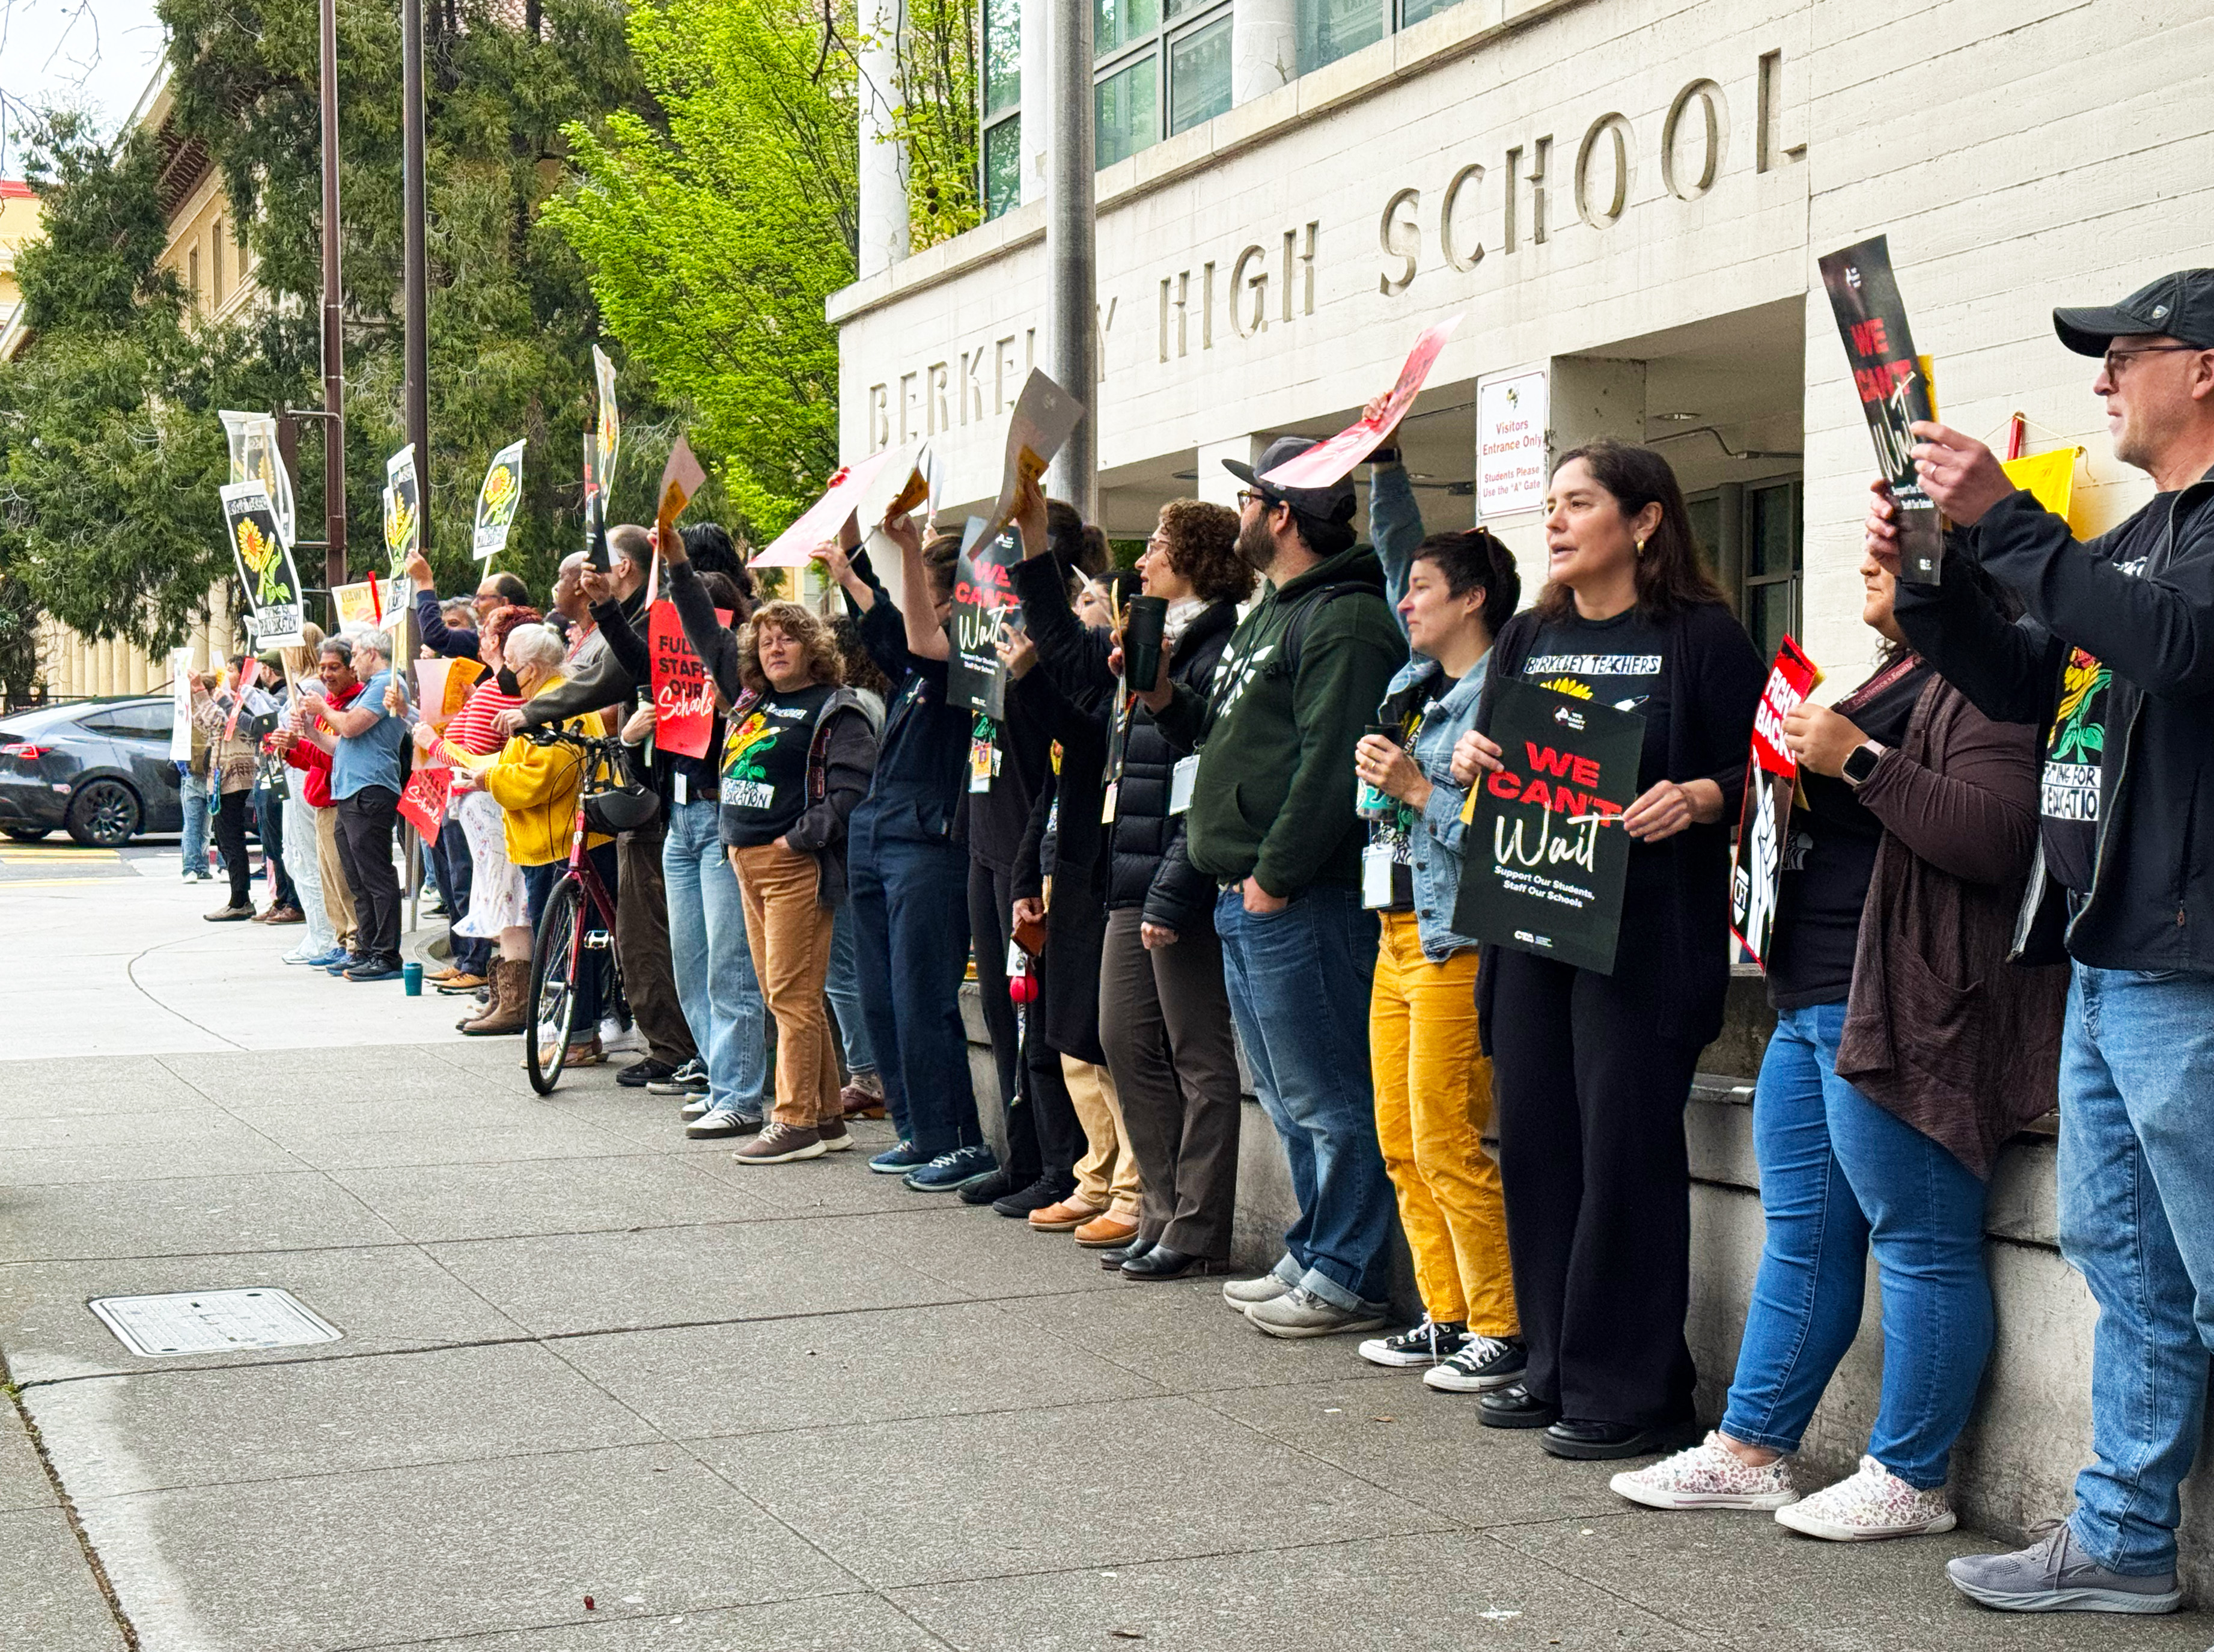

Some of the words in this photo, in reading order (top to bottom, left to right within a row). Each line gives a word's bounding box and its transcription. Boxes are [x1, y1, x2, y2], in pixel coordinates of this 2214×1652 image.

[1159, 219, 1320, 364] HIGH
[1380, 48, 1807, 297] SCHOOL
[1850, 317, 1889, 357] WE
[1496, 420, 1529, 435] Visitors
[1483, 440, 1520, 456] Entrance
[1523, 434, 1543, 448] Only
[1484, 469, 1514, 483] Students
[1516, 465, 1540, 477] Please
[1483, 488, 1496, 498] Use
[1498, 485, 1508, 495] the
[1524, 480, 1540, 490] Gate
[974, 559, 1011, 588] WE
[959, 602, 1021, 650] Wait
[659, 635, 692, 655] FUL
[1591, 656, 1659, 673] TEACHERS
[658, 679, 712, 721] Schools
[669, 678, 703, 698] OUR
[1525, 741, 1600, 788] WE
[2072, 766, 2097, 787] FOR
[1487, 770, 1623, 828] CAN'T
[2048, 787, 2097, 819] EDUCATIO
[1494, 801, 1624, 873] Wait
[1494, 865, 1532, 882] Support
[1534, 875, 1552, 886] Our
[1553, 880, 1595, 900] Students,
[1503, 880, 1527, 893] Staff
[1528, 886, 1546, 898] Our
[1547, 891, 1583, 908] Schools
